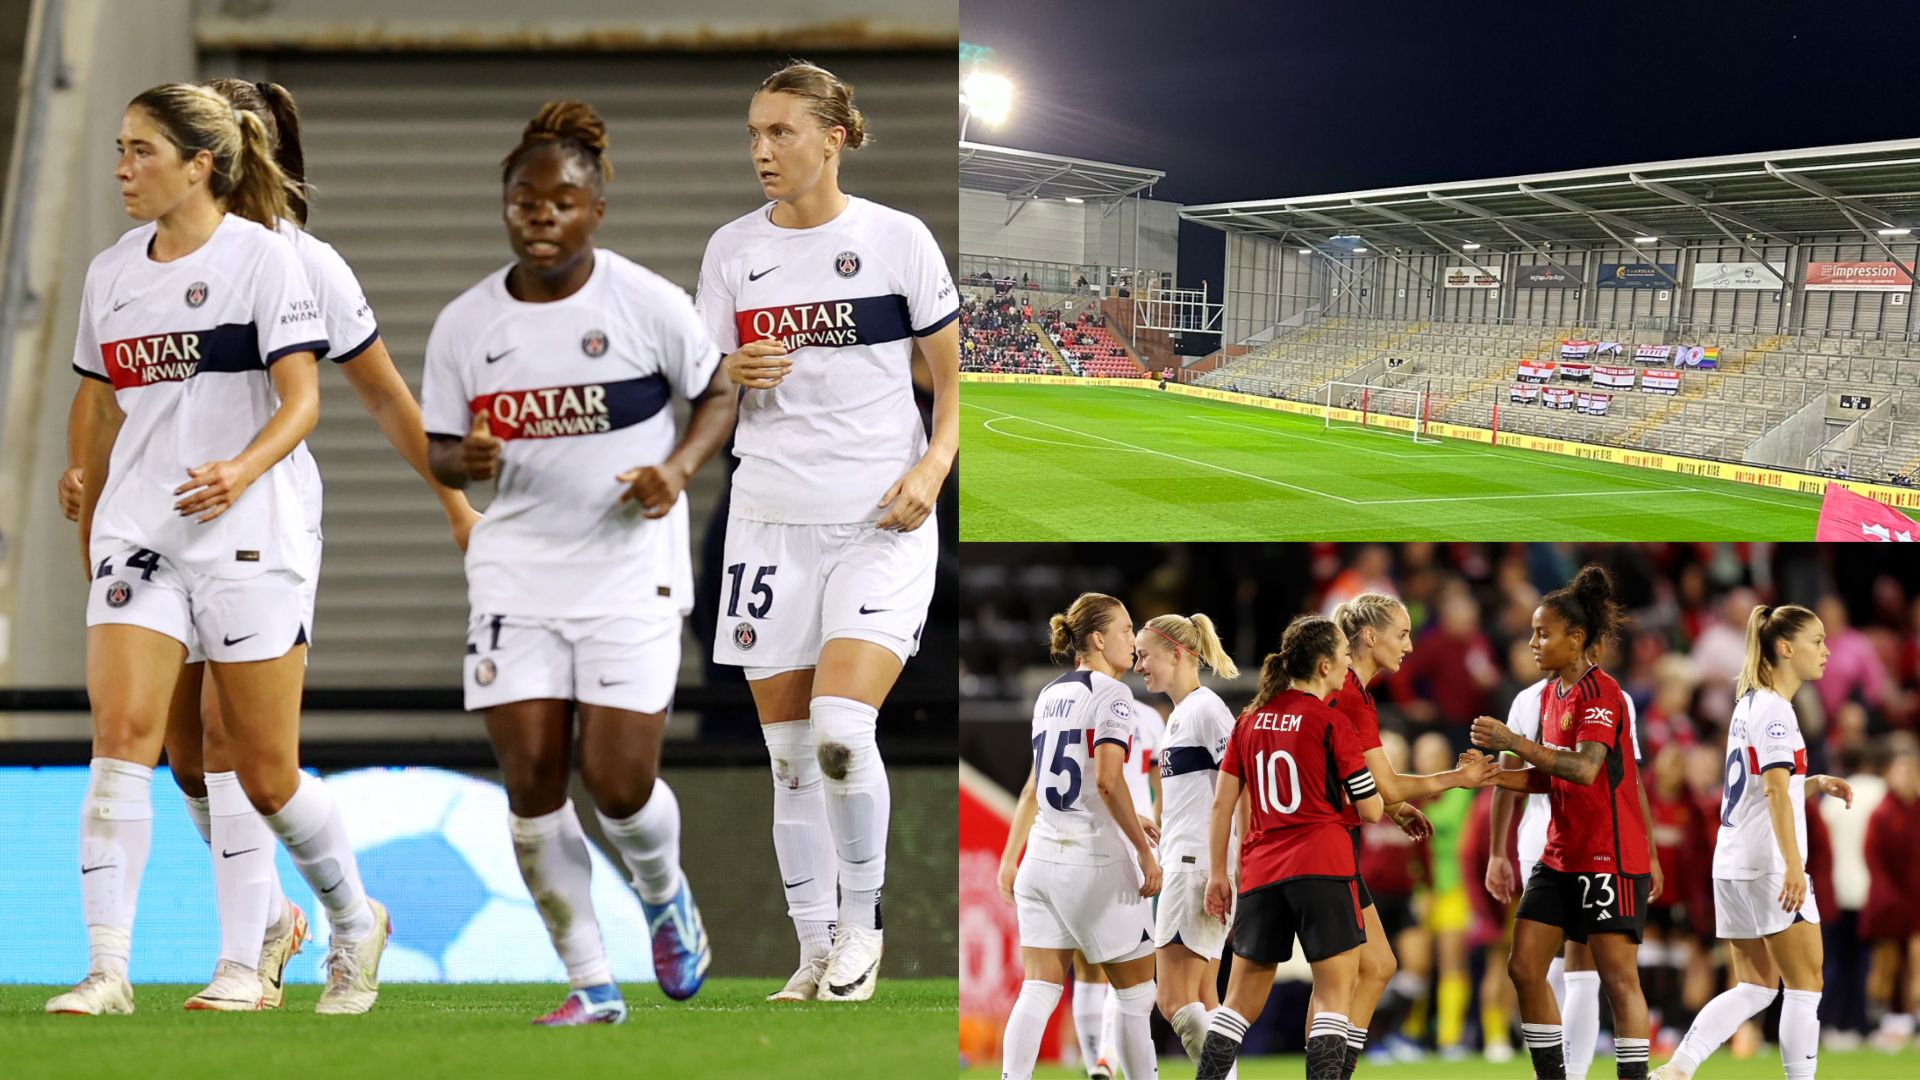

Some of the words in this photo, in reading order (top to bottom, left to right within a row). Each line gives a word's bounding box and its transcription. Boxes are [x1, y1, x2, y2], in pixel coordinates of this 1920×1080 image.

[281, 310, 318, 325] RWAN
[753, 302, 856, 340] QATAR
[115, 333, 202, 373] QATAR
[781, 328, 858, 351] AIRWAYS
[493, 384, 608, 428] QATAR
[522, 415, 611, 438] AIRWAYS
[727, 562, 777, 620] 15
[1043, 698, 1075, 719] HUNT
[1253, 712, 1302, 732] ZELEM
[1032, 728, 1083, 813] 15
[1255, 749, 1302, 815] 10
[1578, 873, 1615, 909] 23
